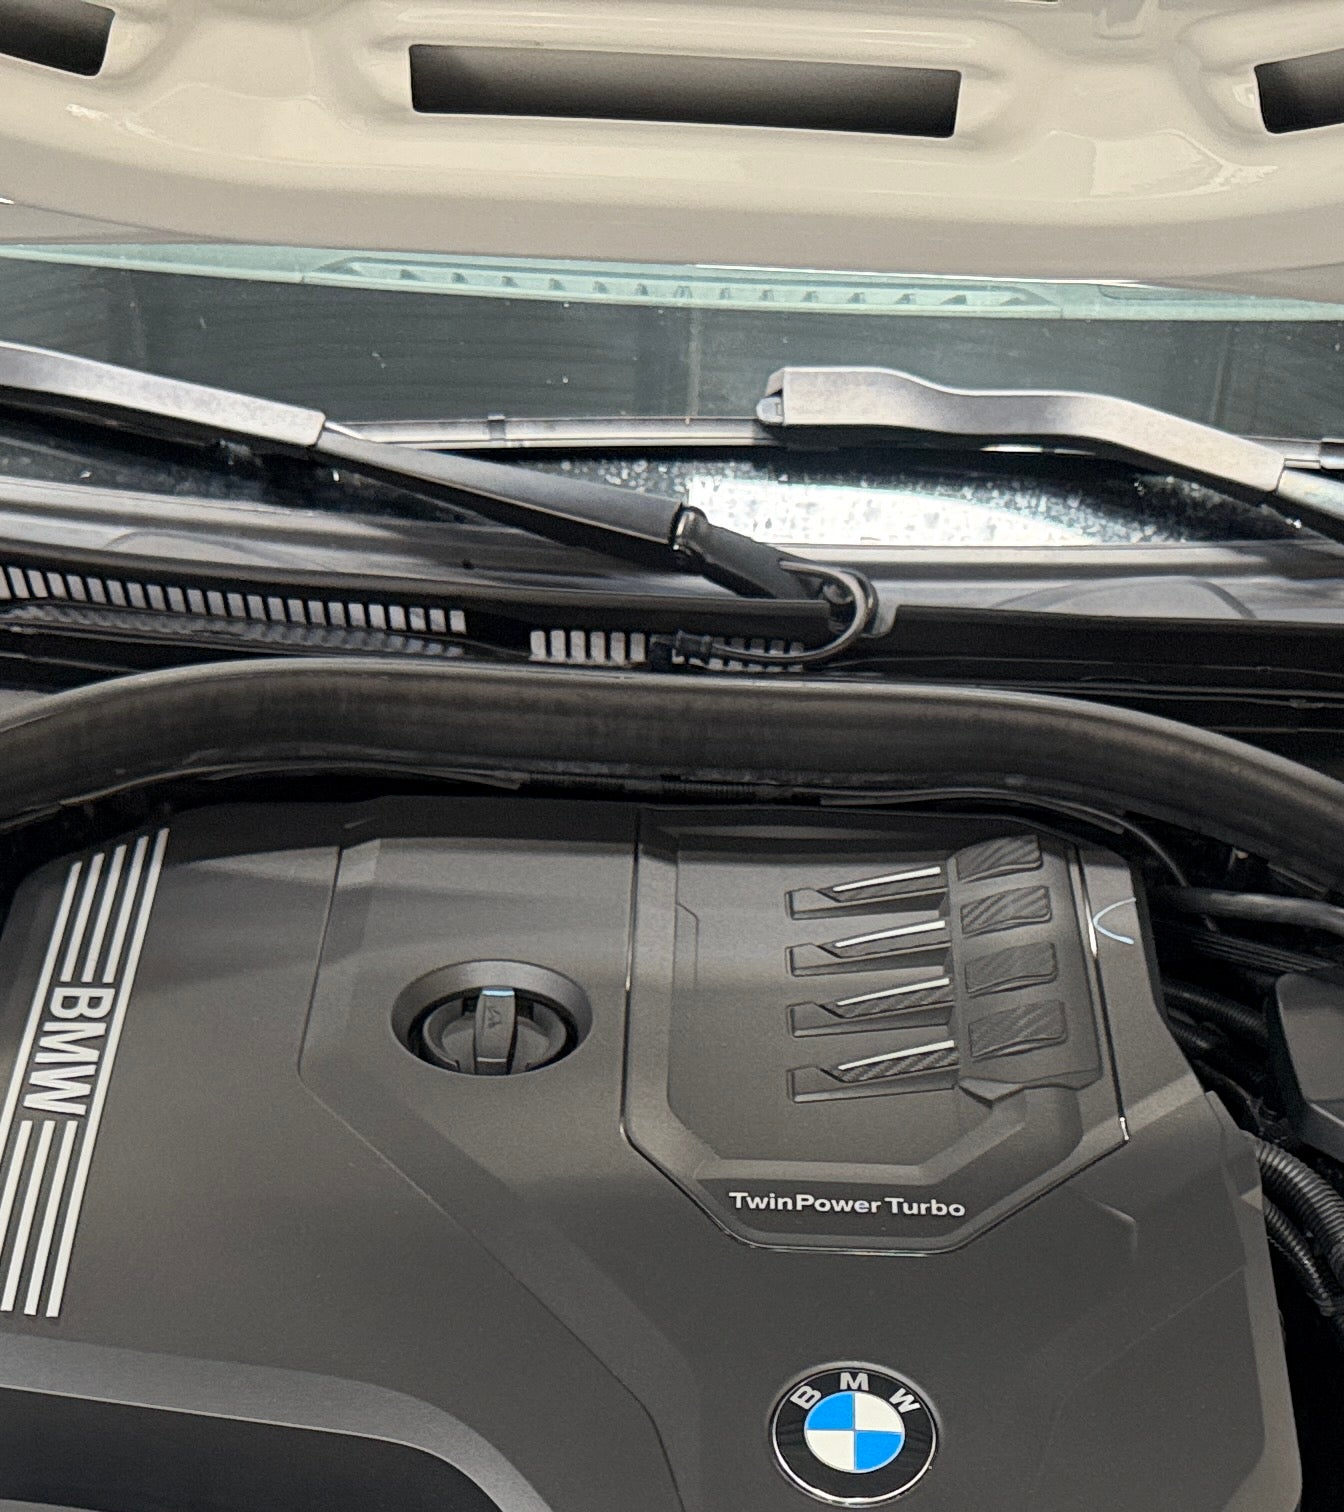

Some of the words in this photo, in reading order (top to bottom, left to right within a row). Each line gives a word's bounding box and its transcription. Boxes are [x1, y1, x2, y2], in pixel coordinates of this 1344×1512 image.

[23, 987, 116, 1116] BMW
[729, 1192, 881, 1213] TwinPower
[885, 1197, 965, 1217] Turbo
[790, 1372, 921, 1414] BMW
